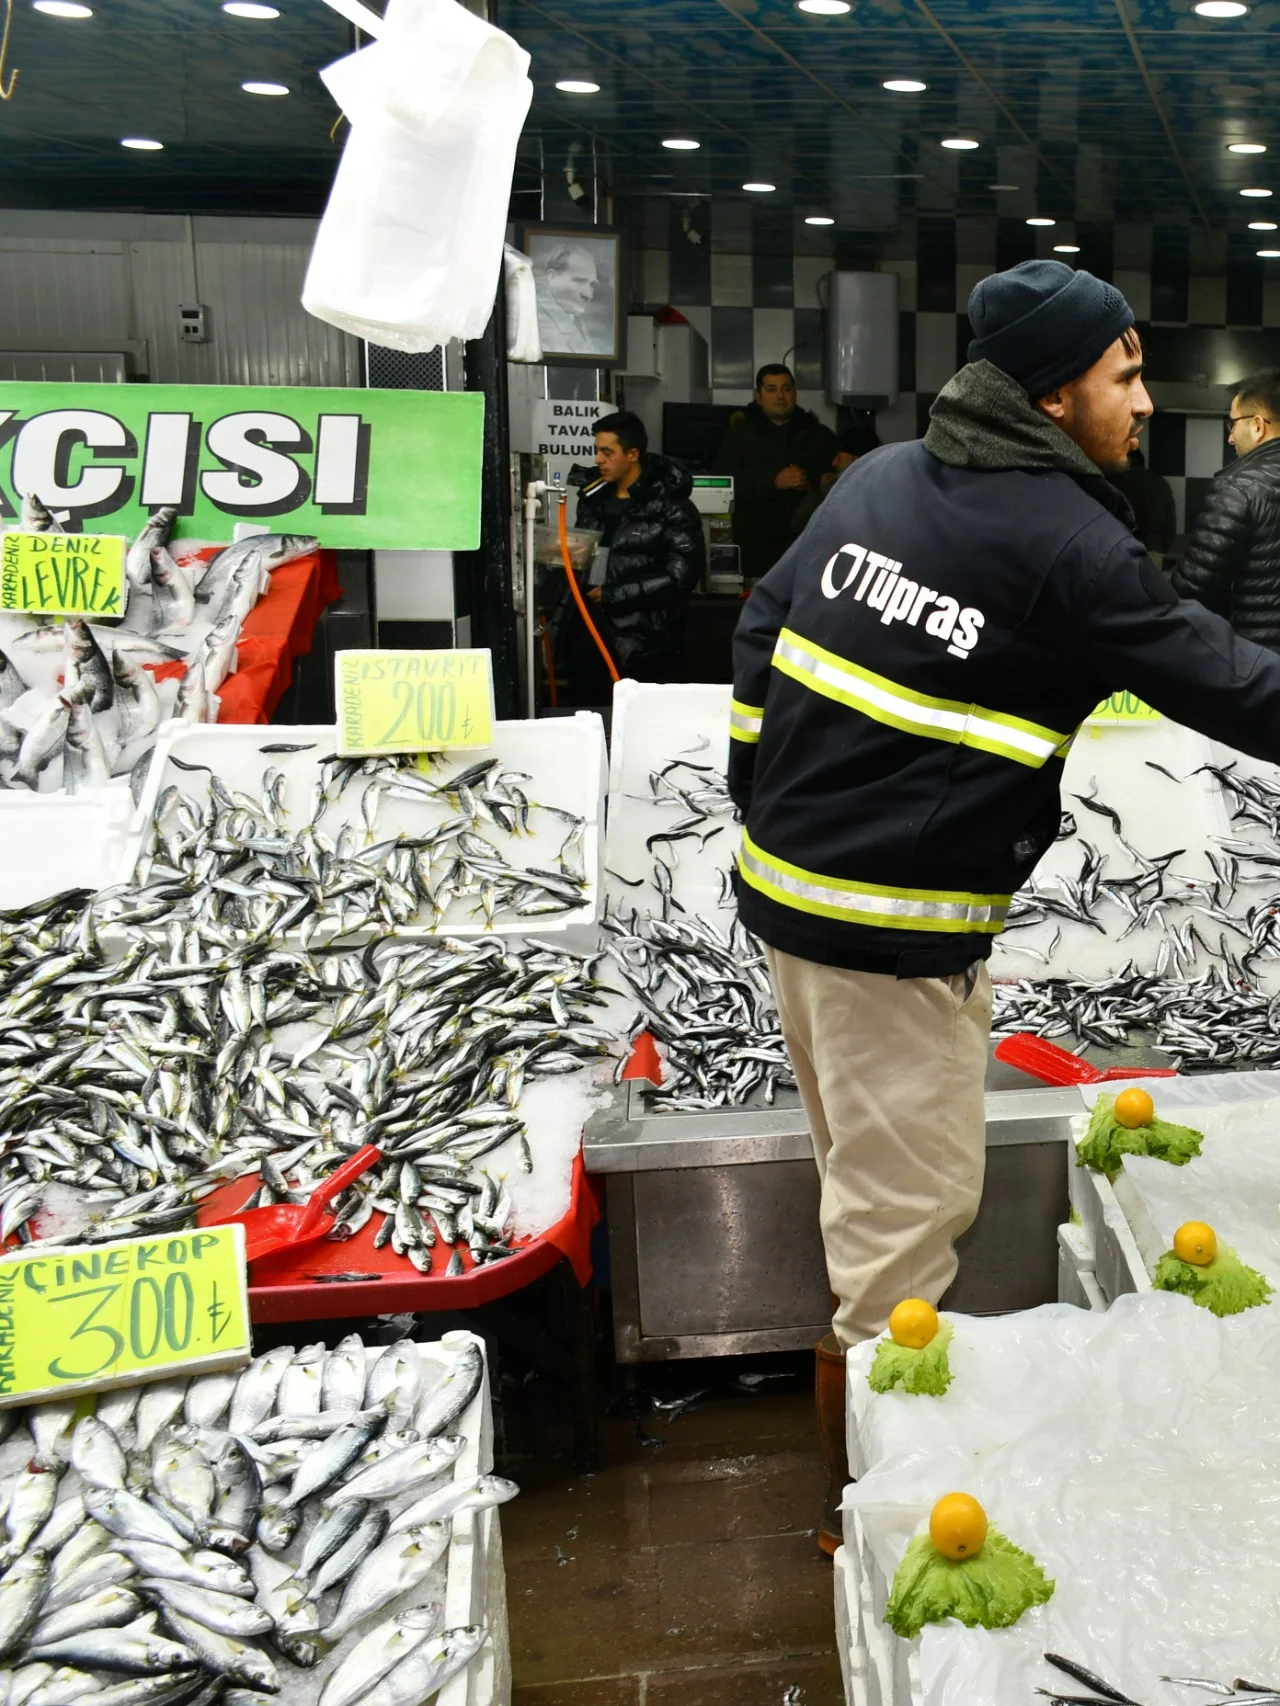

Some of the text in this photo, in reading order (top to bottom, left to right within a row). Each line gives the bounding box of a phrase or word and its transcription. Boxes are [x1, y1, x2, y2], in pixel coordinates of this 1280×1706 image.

[553, 405, 599, 417] BALIK
[0, 408, 371, 531] ÇISI
[539, 444, 597, 456] BULUN
[22, 556, 121, 614] LEVREK
[853, 551, 985, 660] Tüpraş
[23, 1234, 219, 1294] ÇİNEKOP
